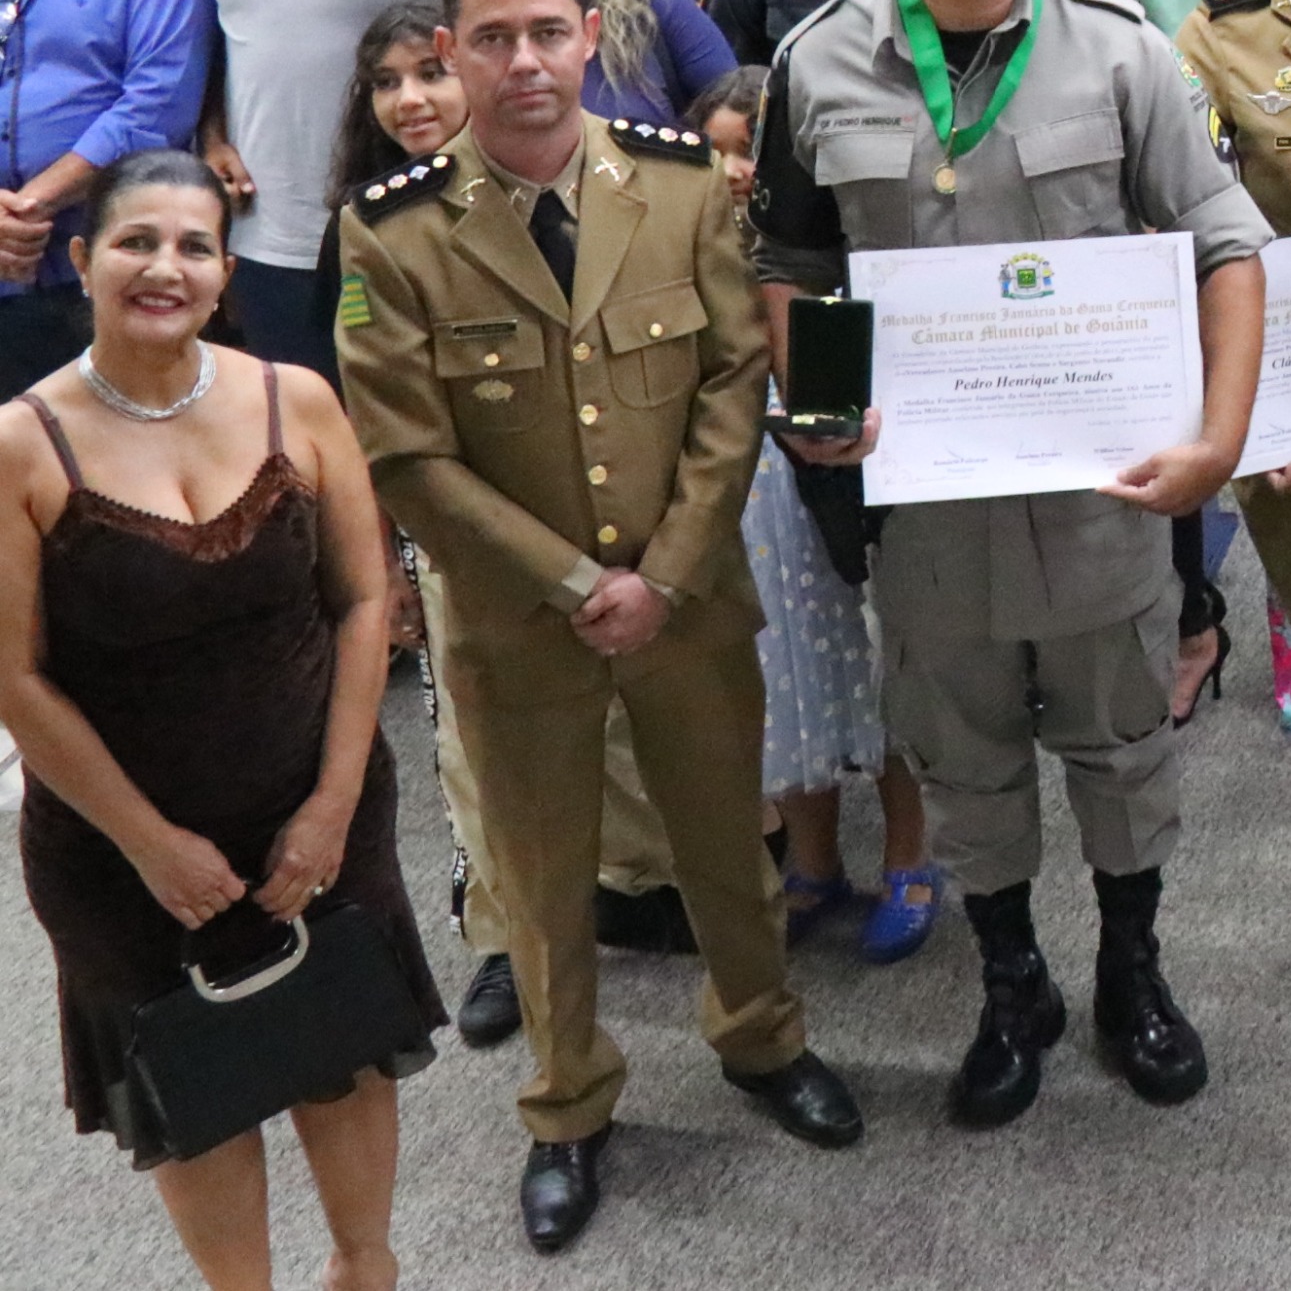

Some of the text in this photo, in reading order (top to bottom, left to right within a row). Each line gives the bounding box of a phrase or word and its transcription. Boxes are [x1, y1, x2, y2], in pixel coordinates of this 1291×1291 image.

[911, 315, 1149, 346] Câmara Municipal de Goiânia
[954, 369, 1114, 391] Pedro Henrique Mendes
